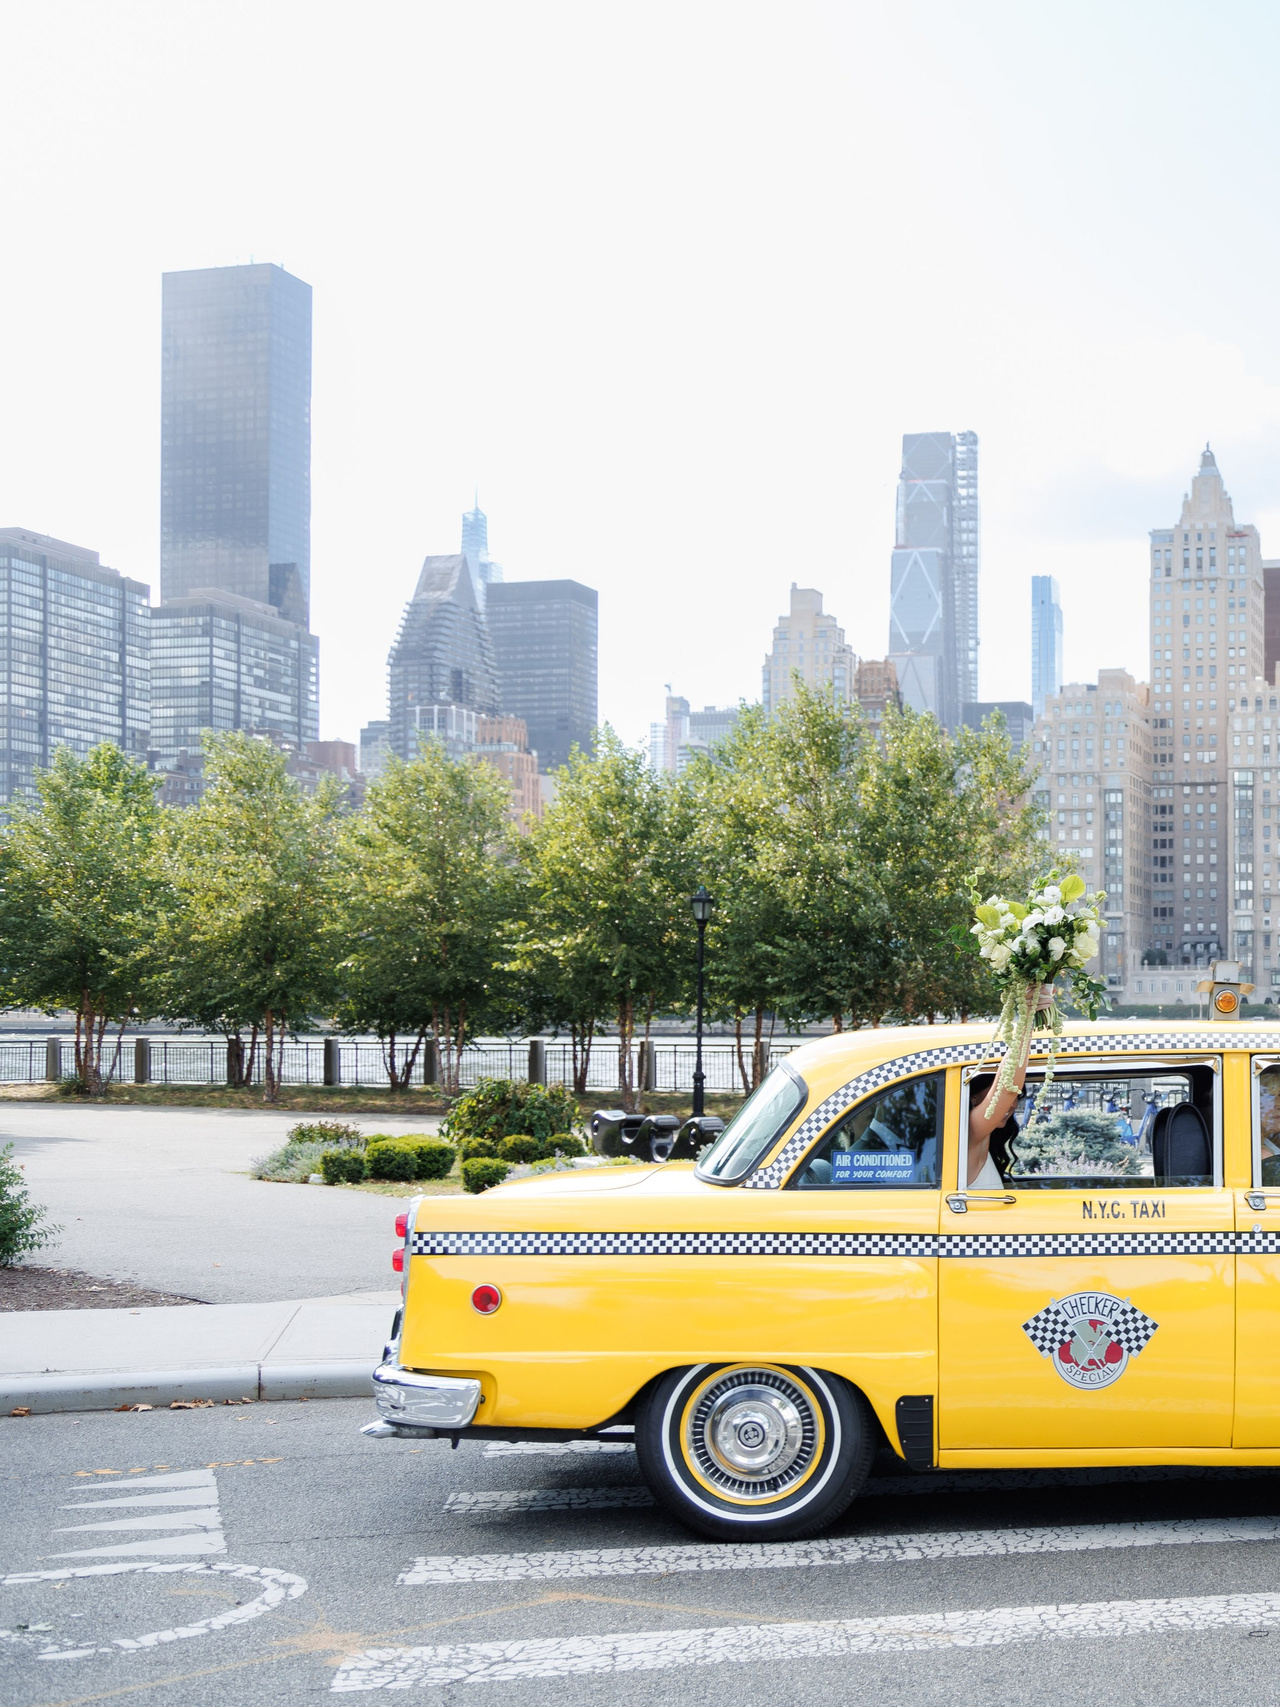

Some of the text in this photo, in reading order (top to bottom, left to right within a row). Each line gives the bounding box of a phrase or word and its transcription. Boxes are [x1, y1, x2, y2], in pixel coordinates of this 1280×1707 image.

[835, 1154, 912, 1167] AIR CONDITIONED
[835, 1170, 912, 1178] FOR YOUR COMFORT
[1082, 1200, 1166, 1219] N.Y.C. TAXI
[1061, 1296, 1120, 1319] CHECKER
[1066, 1364, 1116, 1382] SPECIAL
